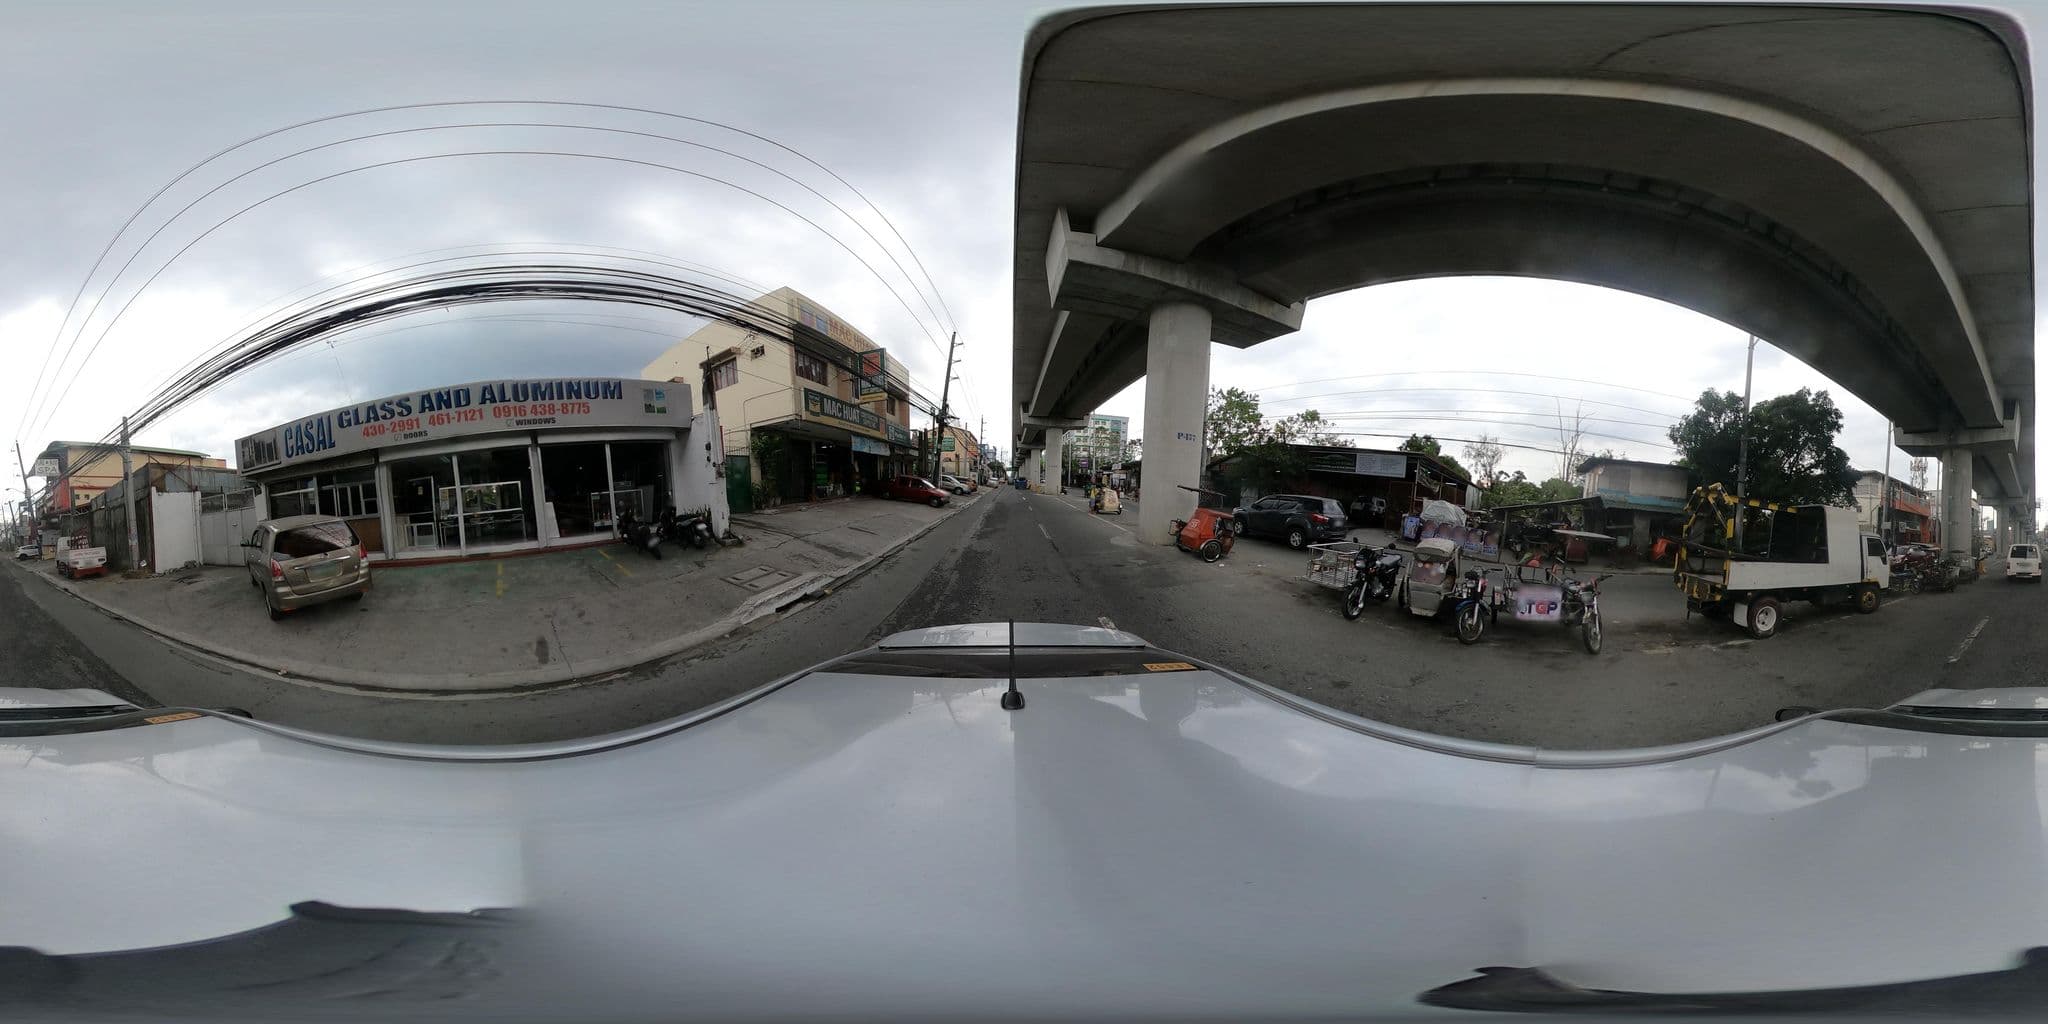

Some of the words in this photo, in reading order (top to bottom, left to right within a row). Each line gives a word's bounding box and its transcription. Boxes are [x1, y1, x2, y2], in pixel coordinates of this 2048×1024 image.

[284, 413, 336, 458] CASAL
[337, 397, 412, 428] GLASS
[418, 387, 471, 413] AND
[478, 380, 623, 405] ALUMINUM
[823, 398, 843, 418] MAC
[843, 404, 860, 423] HUAT
[362, 417, 420, 438] 430-2991
[428, 407, 484, 427] 461-7121
[493, 405, 527, 419] 0916
[530, 402, 591, 417] 438-8775
[515, 417, 557, 426] WINDOWS
[403, 430, 428, 439] DOORS
[36, 466, 57, 474] SPA
